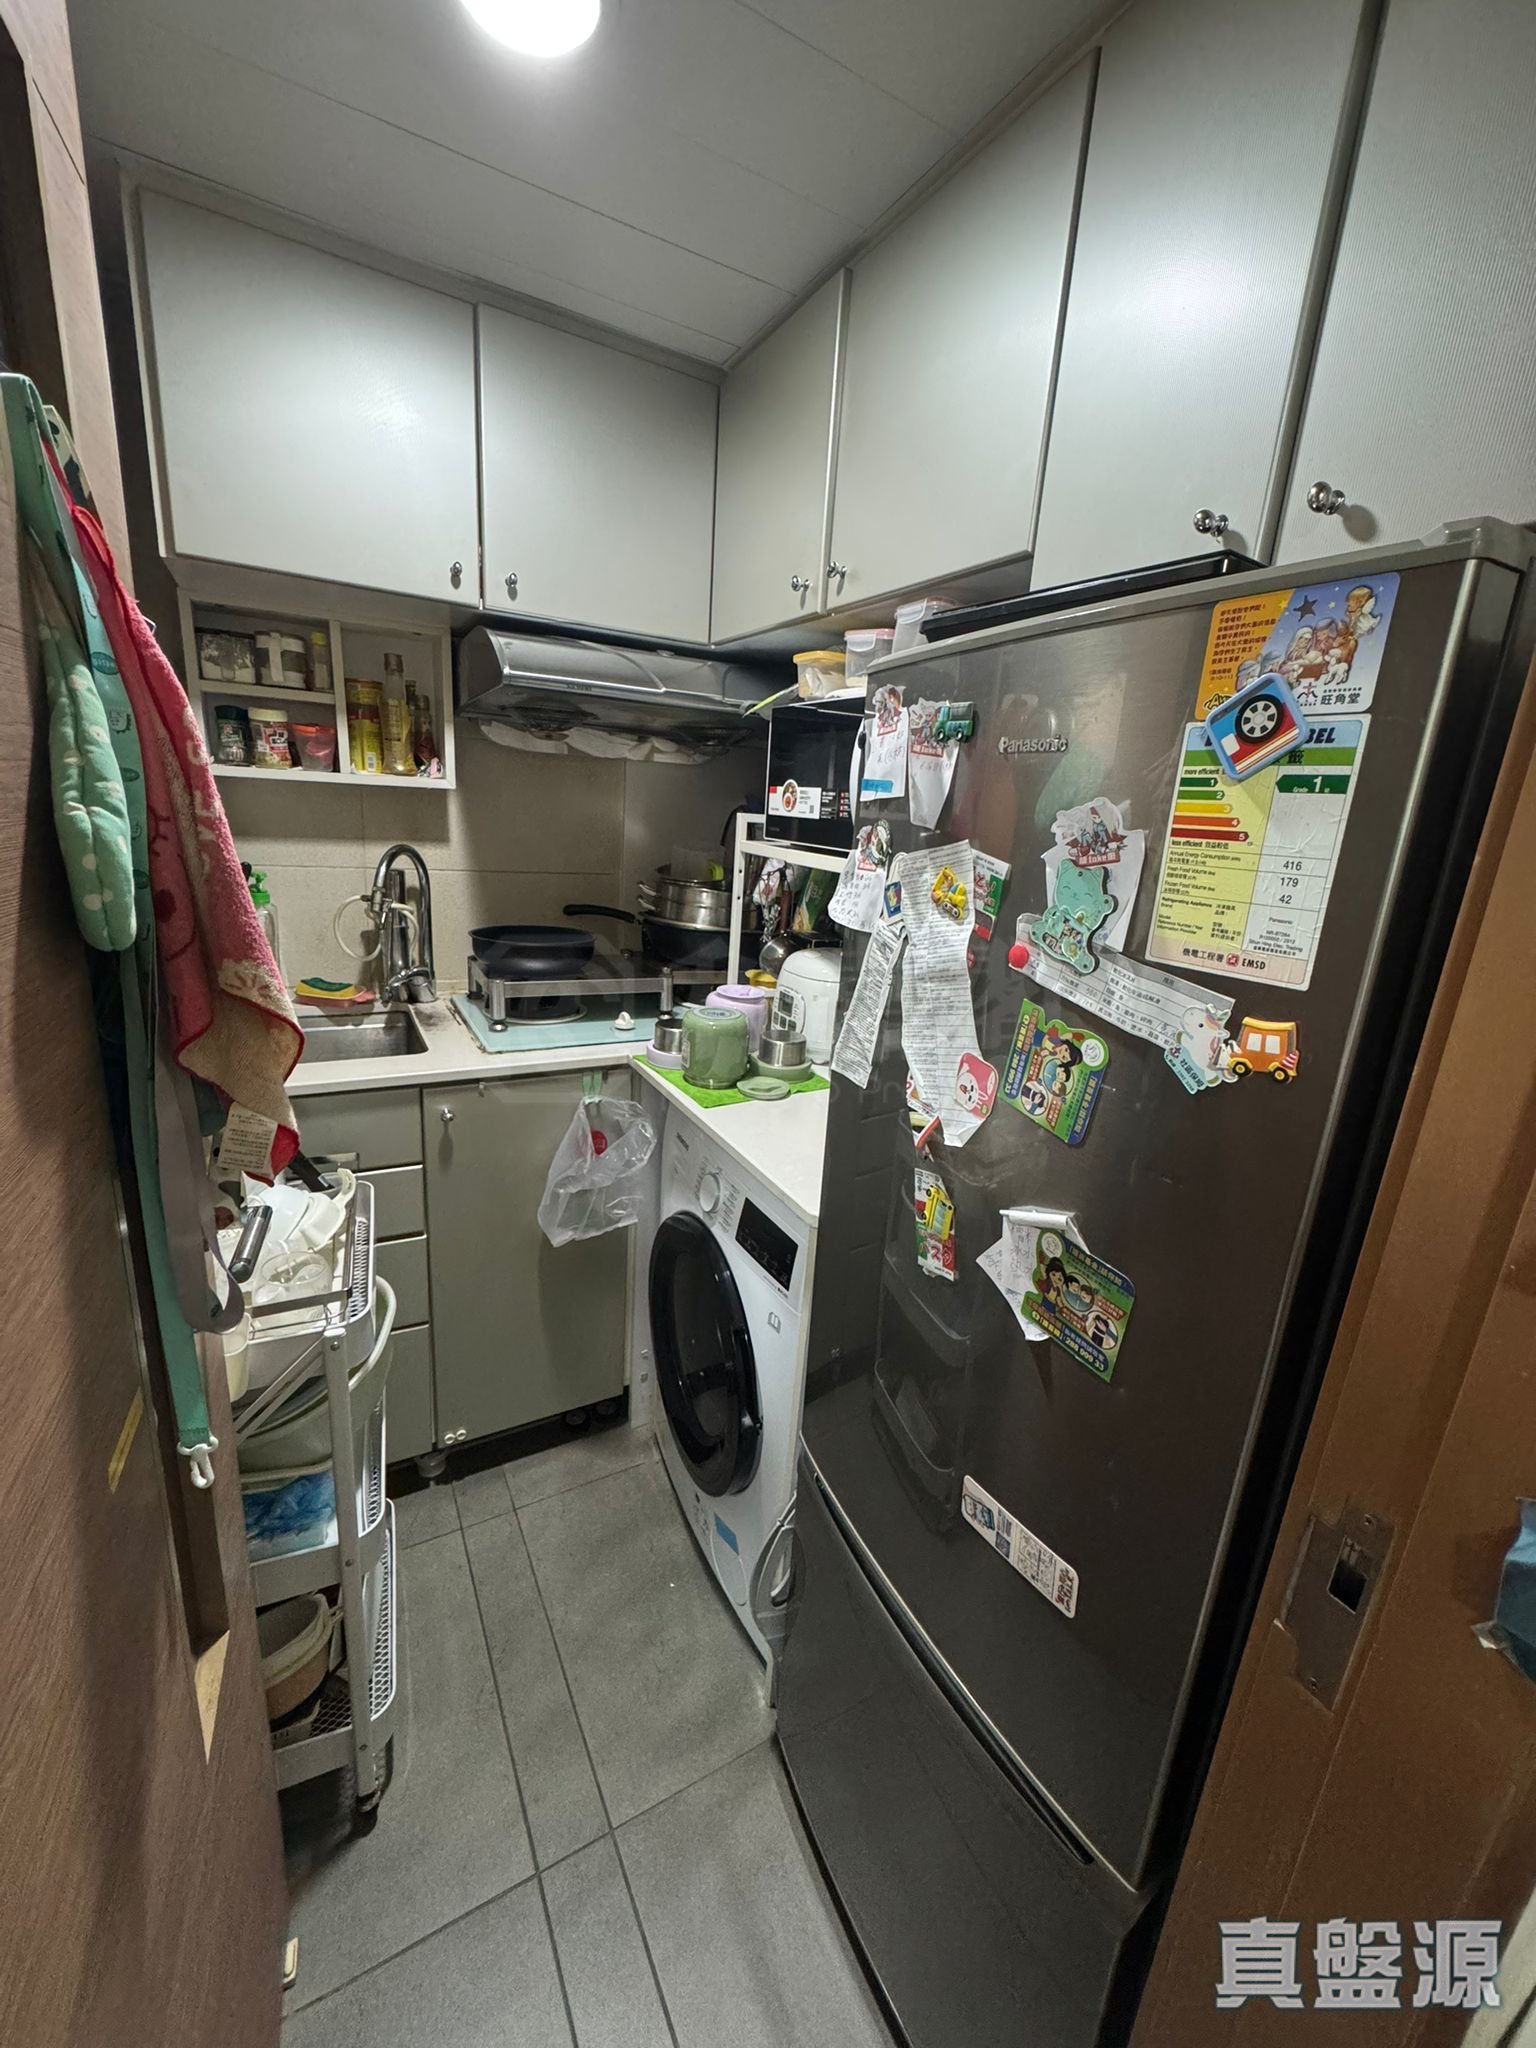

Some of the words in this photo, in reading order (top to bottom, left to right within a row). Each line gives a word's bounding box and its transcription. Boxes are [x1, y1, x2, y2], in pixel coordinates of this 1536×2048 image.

[1320, 693, 1361, 705] 旺角堂
[1306, 727, 1336, 744] BEL
[998, 735, 1067, 753] Panasonic
[1313, 776, 1323, 793] 1
[1216, 791, 1223, 799] 2
[1231, 818, 1238, 826] 4
[1238, 833, 1246, 841] 5
[1283, 860, 1303, 871] 416
[1280, 877, 1299, 888] 179
[1278, 894, 1293, 905] 42
[1182, 948, 1225, 962] 機電工程署
[1241, 958, 1266, 970] EMSD
